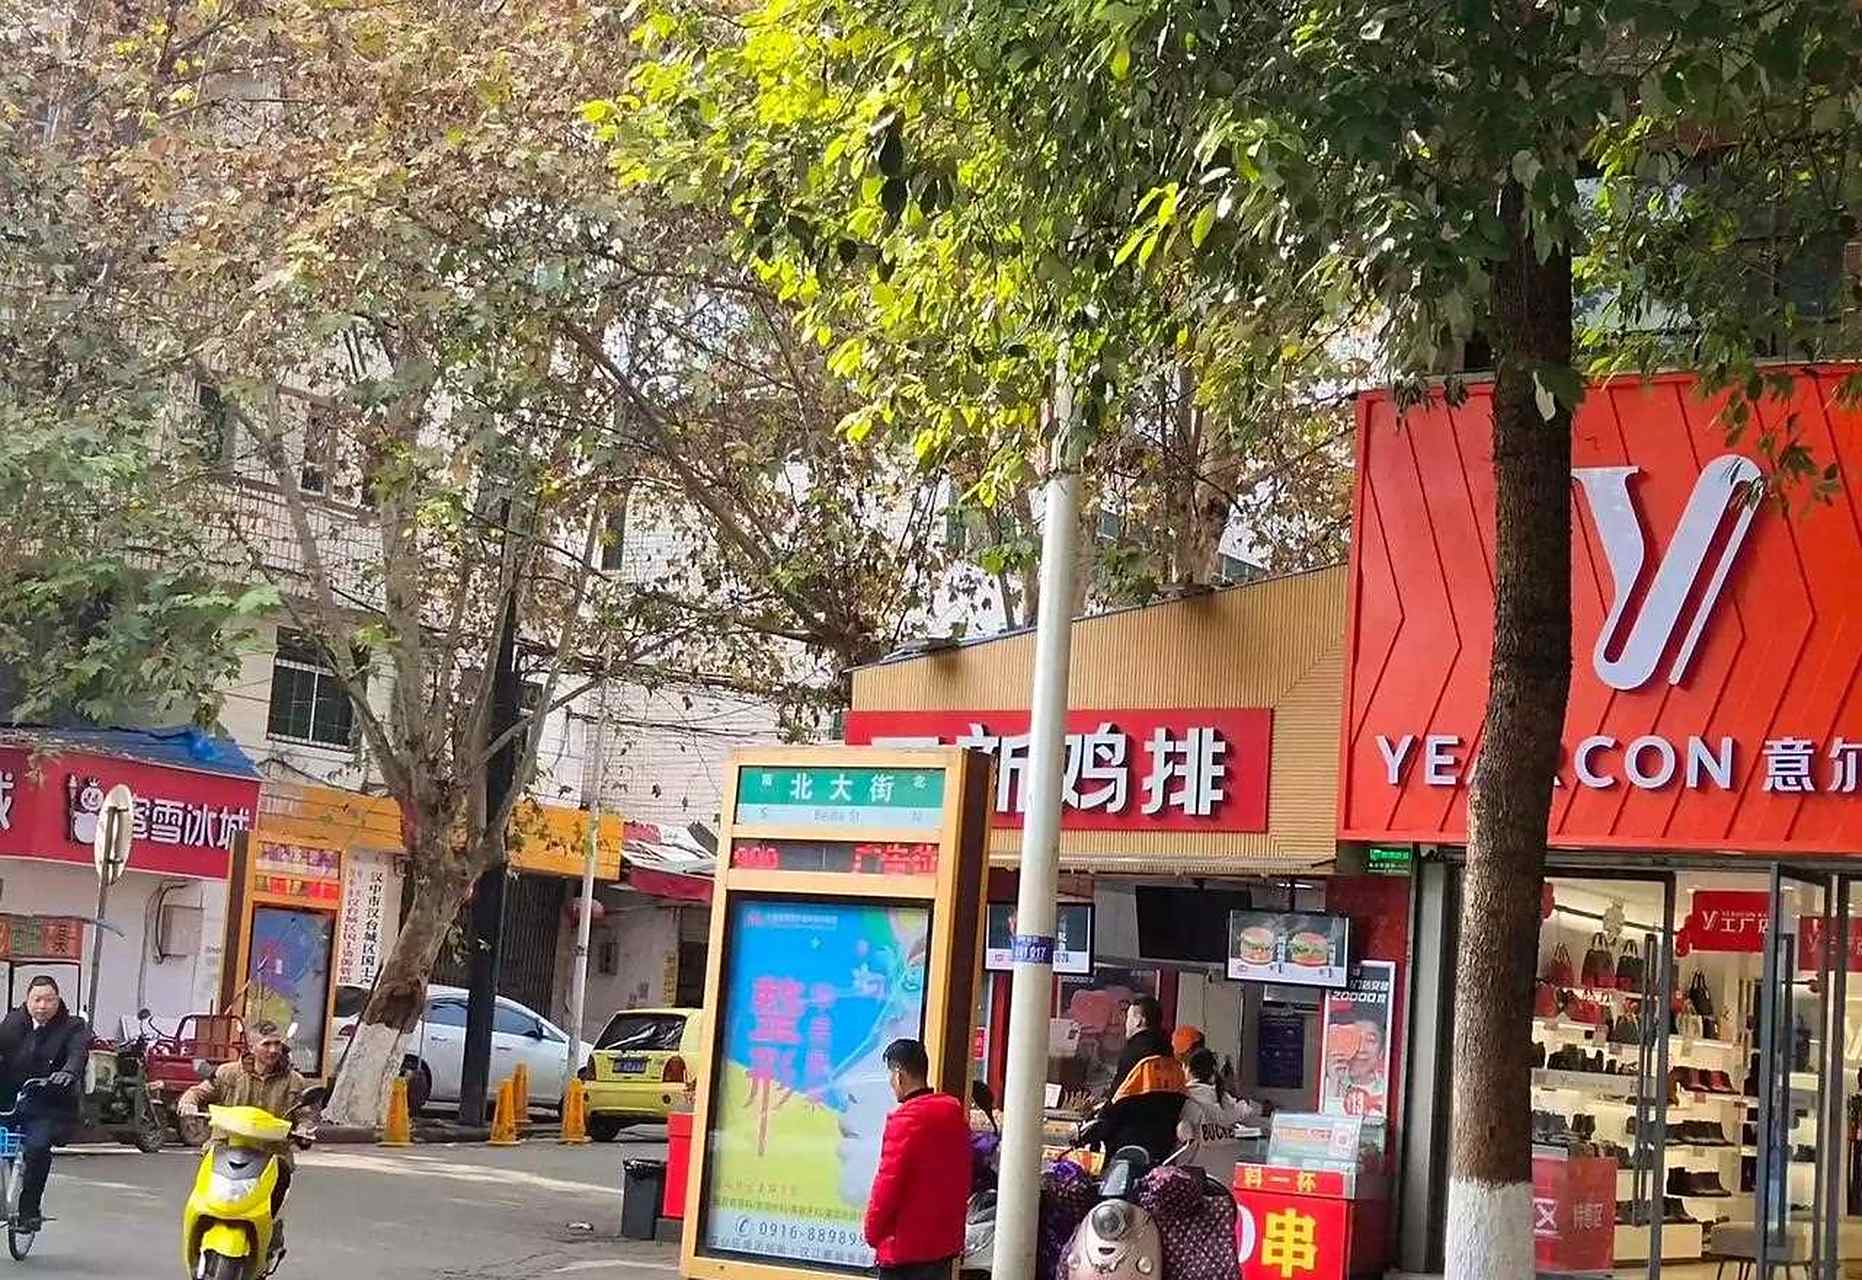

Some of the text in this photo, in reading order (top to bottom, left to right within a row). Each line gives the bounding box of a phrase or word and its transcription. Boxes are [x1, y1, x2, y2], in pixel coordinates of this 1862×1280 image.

[790, 772, 896, 803] 北大街
[1375, 735, 1735, 790] YECON
[1260, 1207, 1319, 1278] 串
